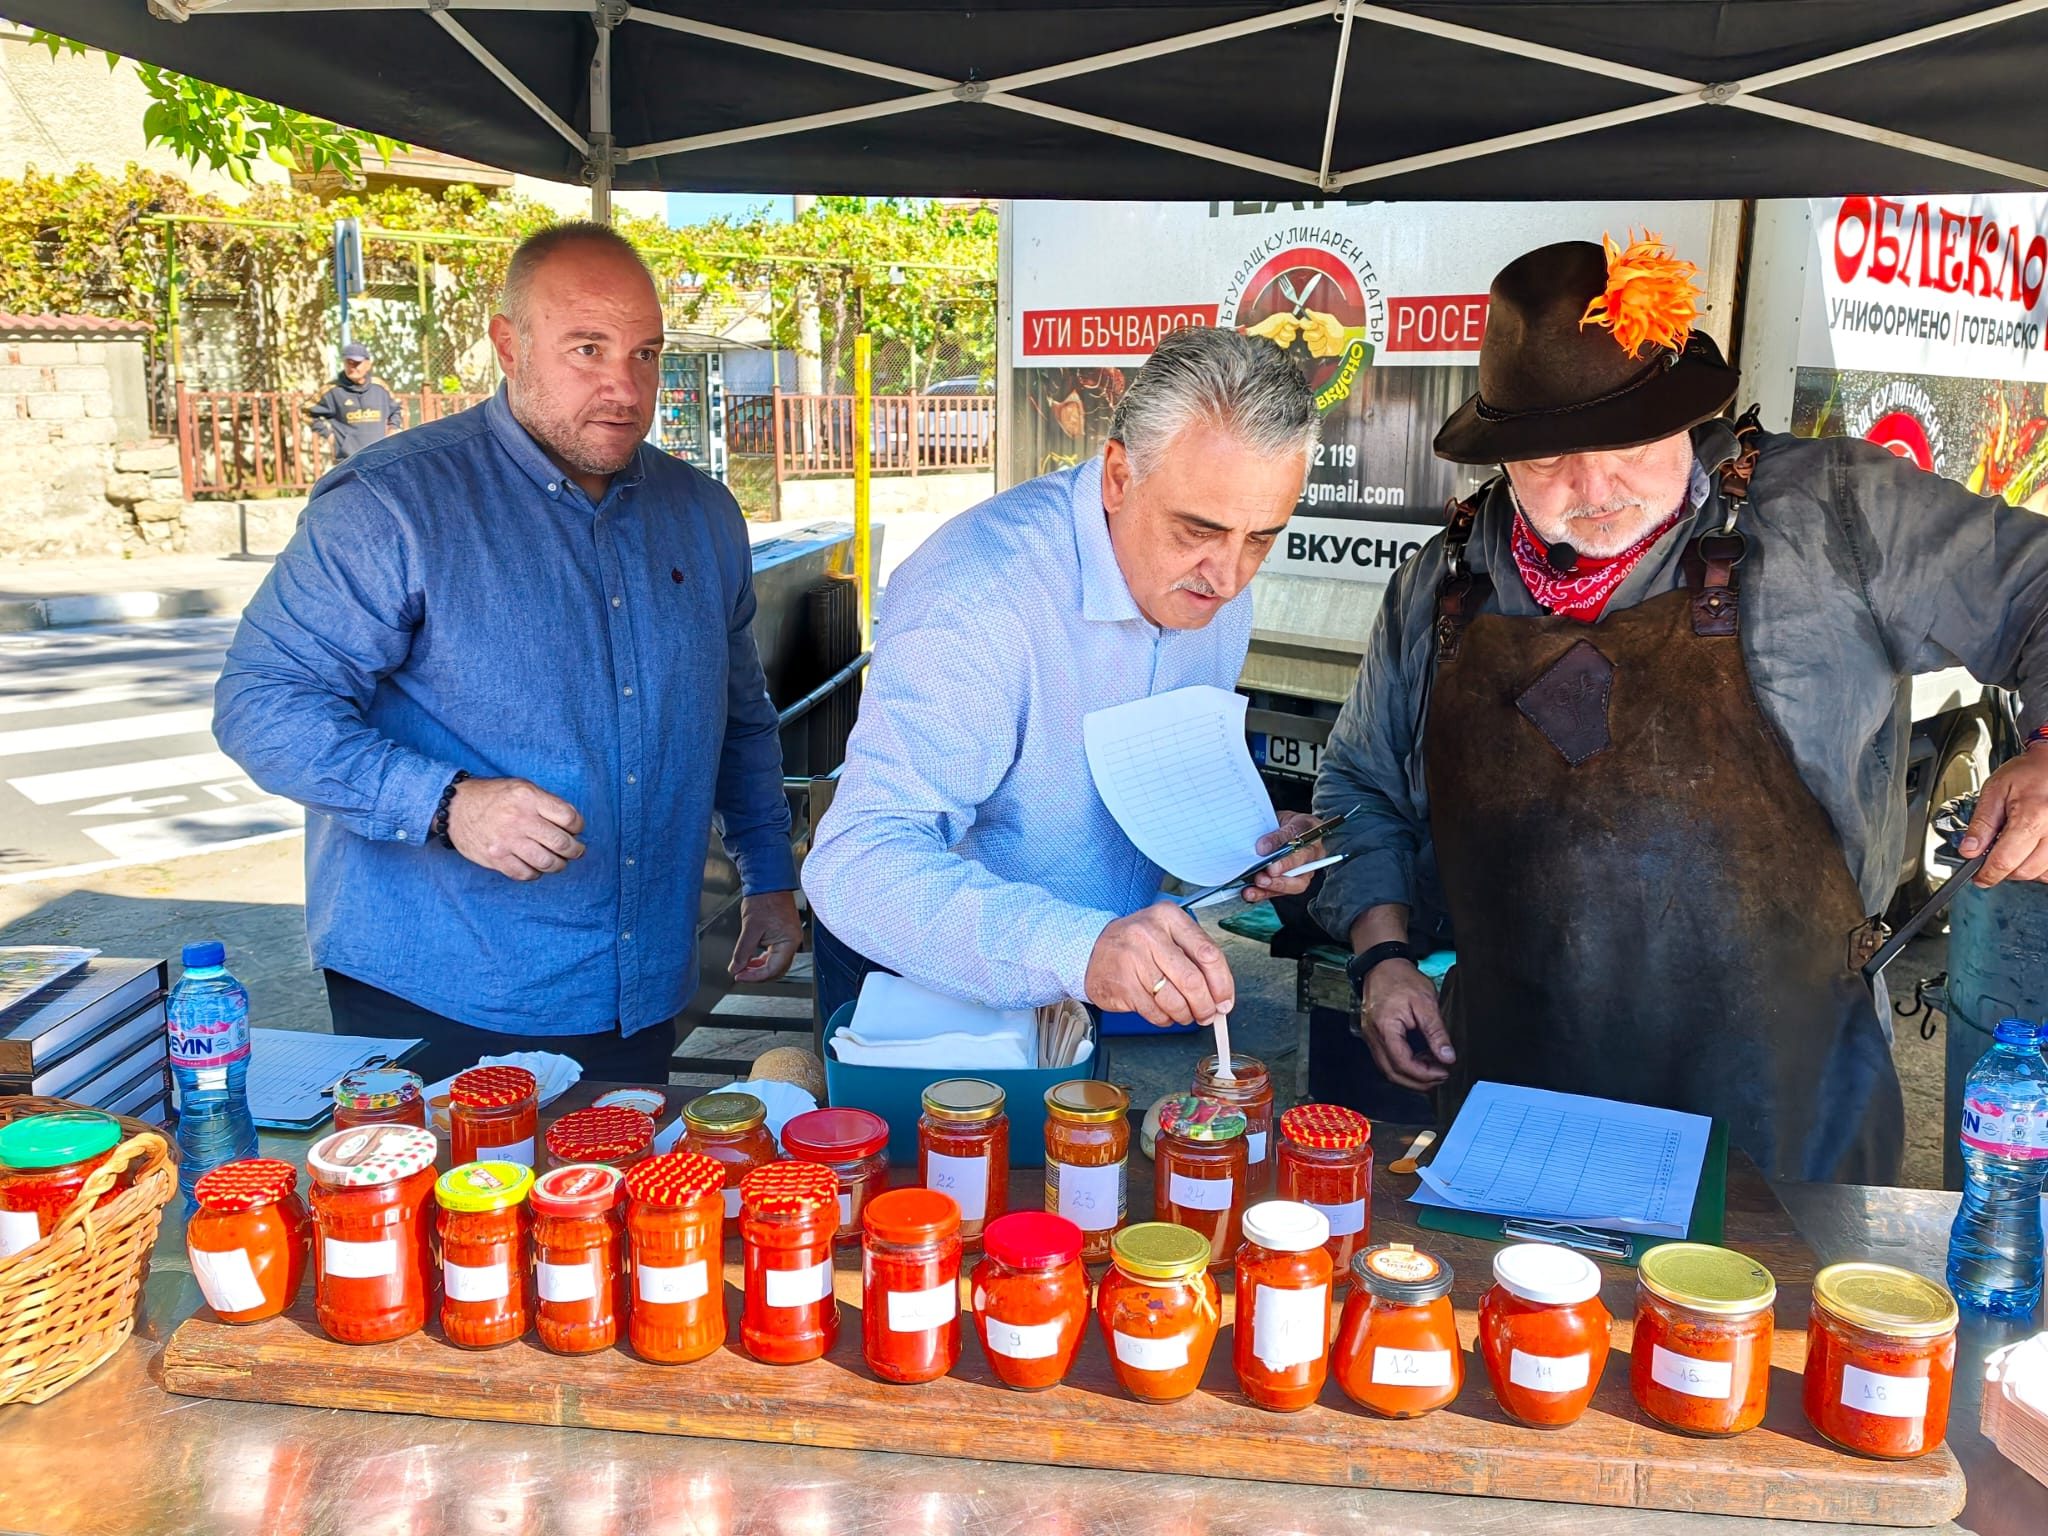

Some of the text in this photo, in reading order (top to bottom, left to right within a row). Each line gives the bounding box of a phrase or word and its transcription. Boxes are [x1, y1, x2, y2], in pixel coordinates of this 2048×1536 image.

[1834, 194, 2048, 312] ОБЛЕКЛО
[1220, 226, 1385, 343] ЪТУВАЩ КУЛИНАРЕН ТЕАТЪР
[1032, 317, 1071, 349] УТИ
[1830, 297, 2039, 350] УНИФОРМЕНО ГОТВАРСКО
[1329, 444, 1357, 468] 119
[169, 1035, 213, 1055] EVIN
[936, 1173, 955, 1189] 22
[1072, 1190, 1096, 1209] 23
[1009, 1331, 1021, 1346] 9
[1391, 1354, 1419, 1374] 12
[1680, 1368, 1701, 1383] 15
[1863, 1383, 1887, 1401] 16
